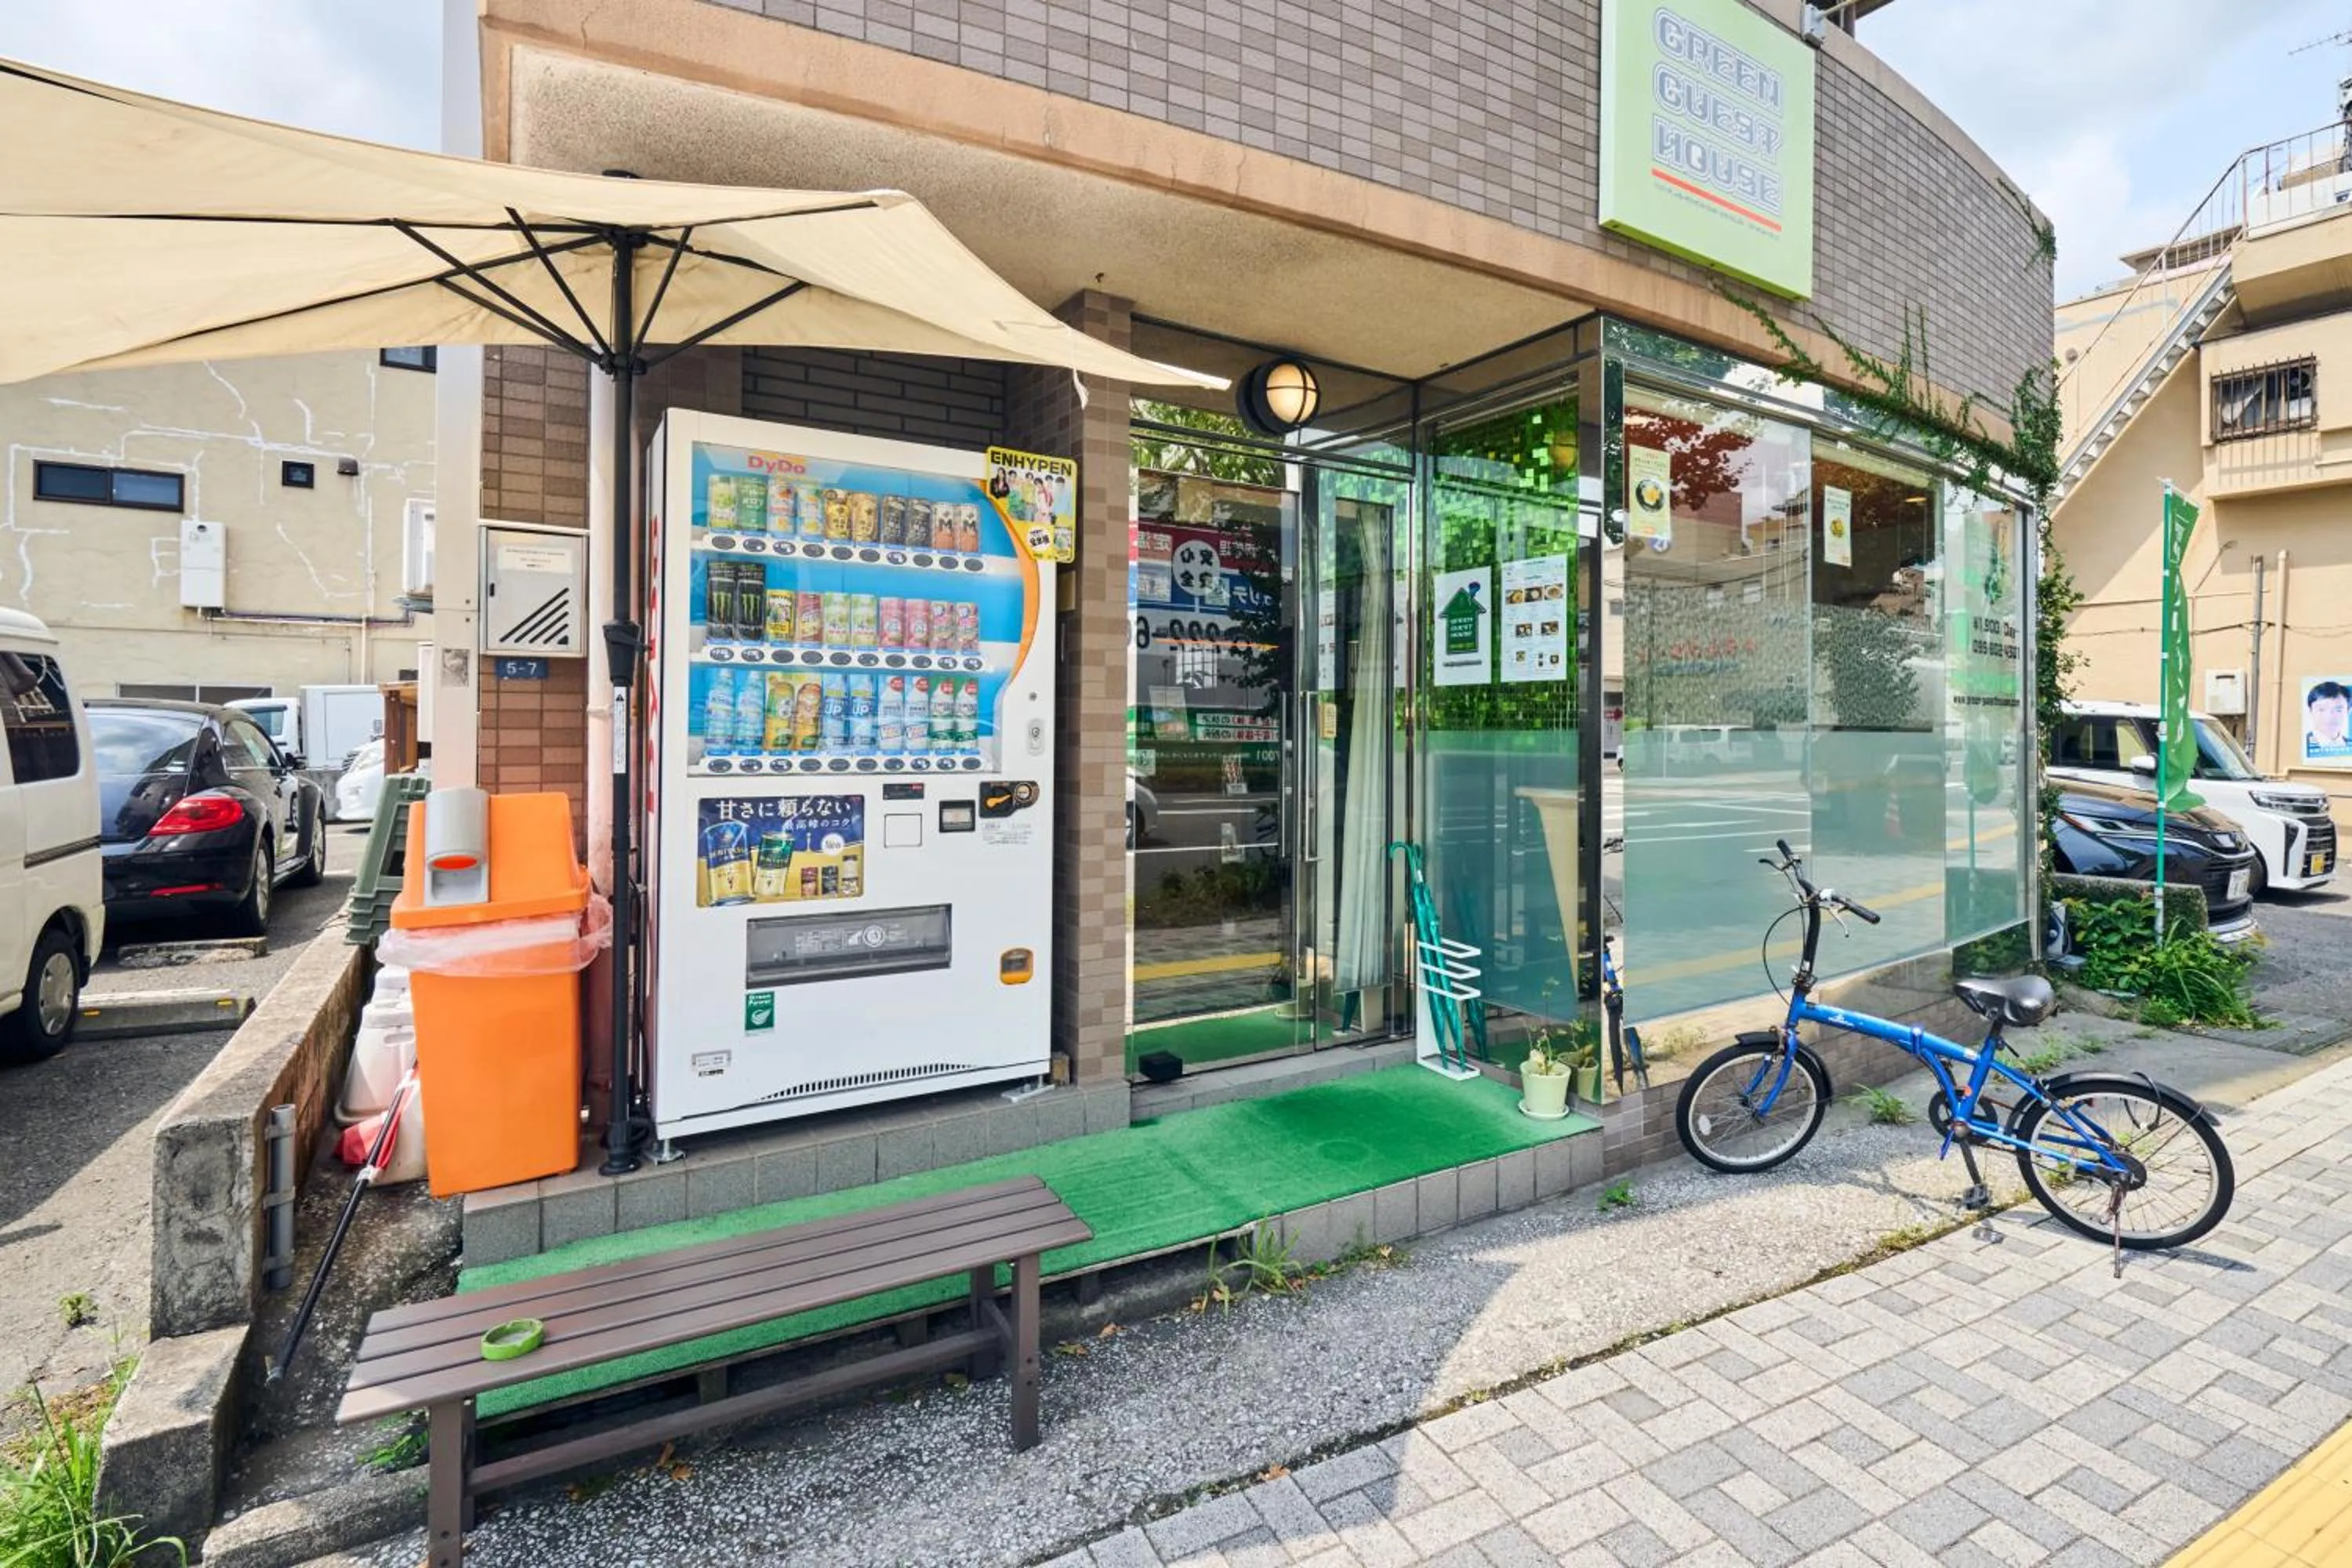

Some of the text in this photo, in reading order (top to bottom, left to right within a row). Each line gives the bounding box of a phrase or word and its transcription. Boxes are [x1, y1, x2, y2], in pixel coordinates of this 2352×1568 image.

[1655, 8, 1782, 116] GREEN
[1654, 62, 1782, 162] GUEST
[1653, 115, 1781, 216] HOUSE
[747, 455, 807, 474] DyDo
[990, 449, 1073, 477] ENHYPEN
[506, 661, 537, 675] 5-7
[716, 797, 851, 820] 甘さに頼らない
